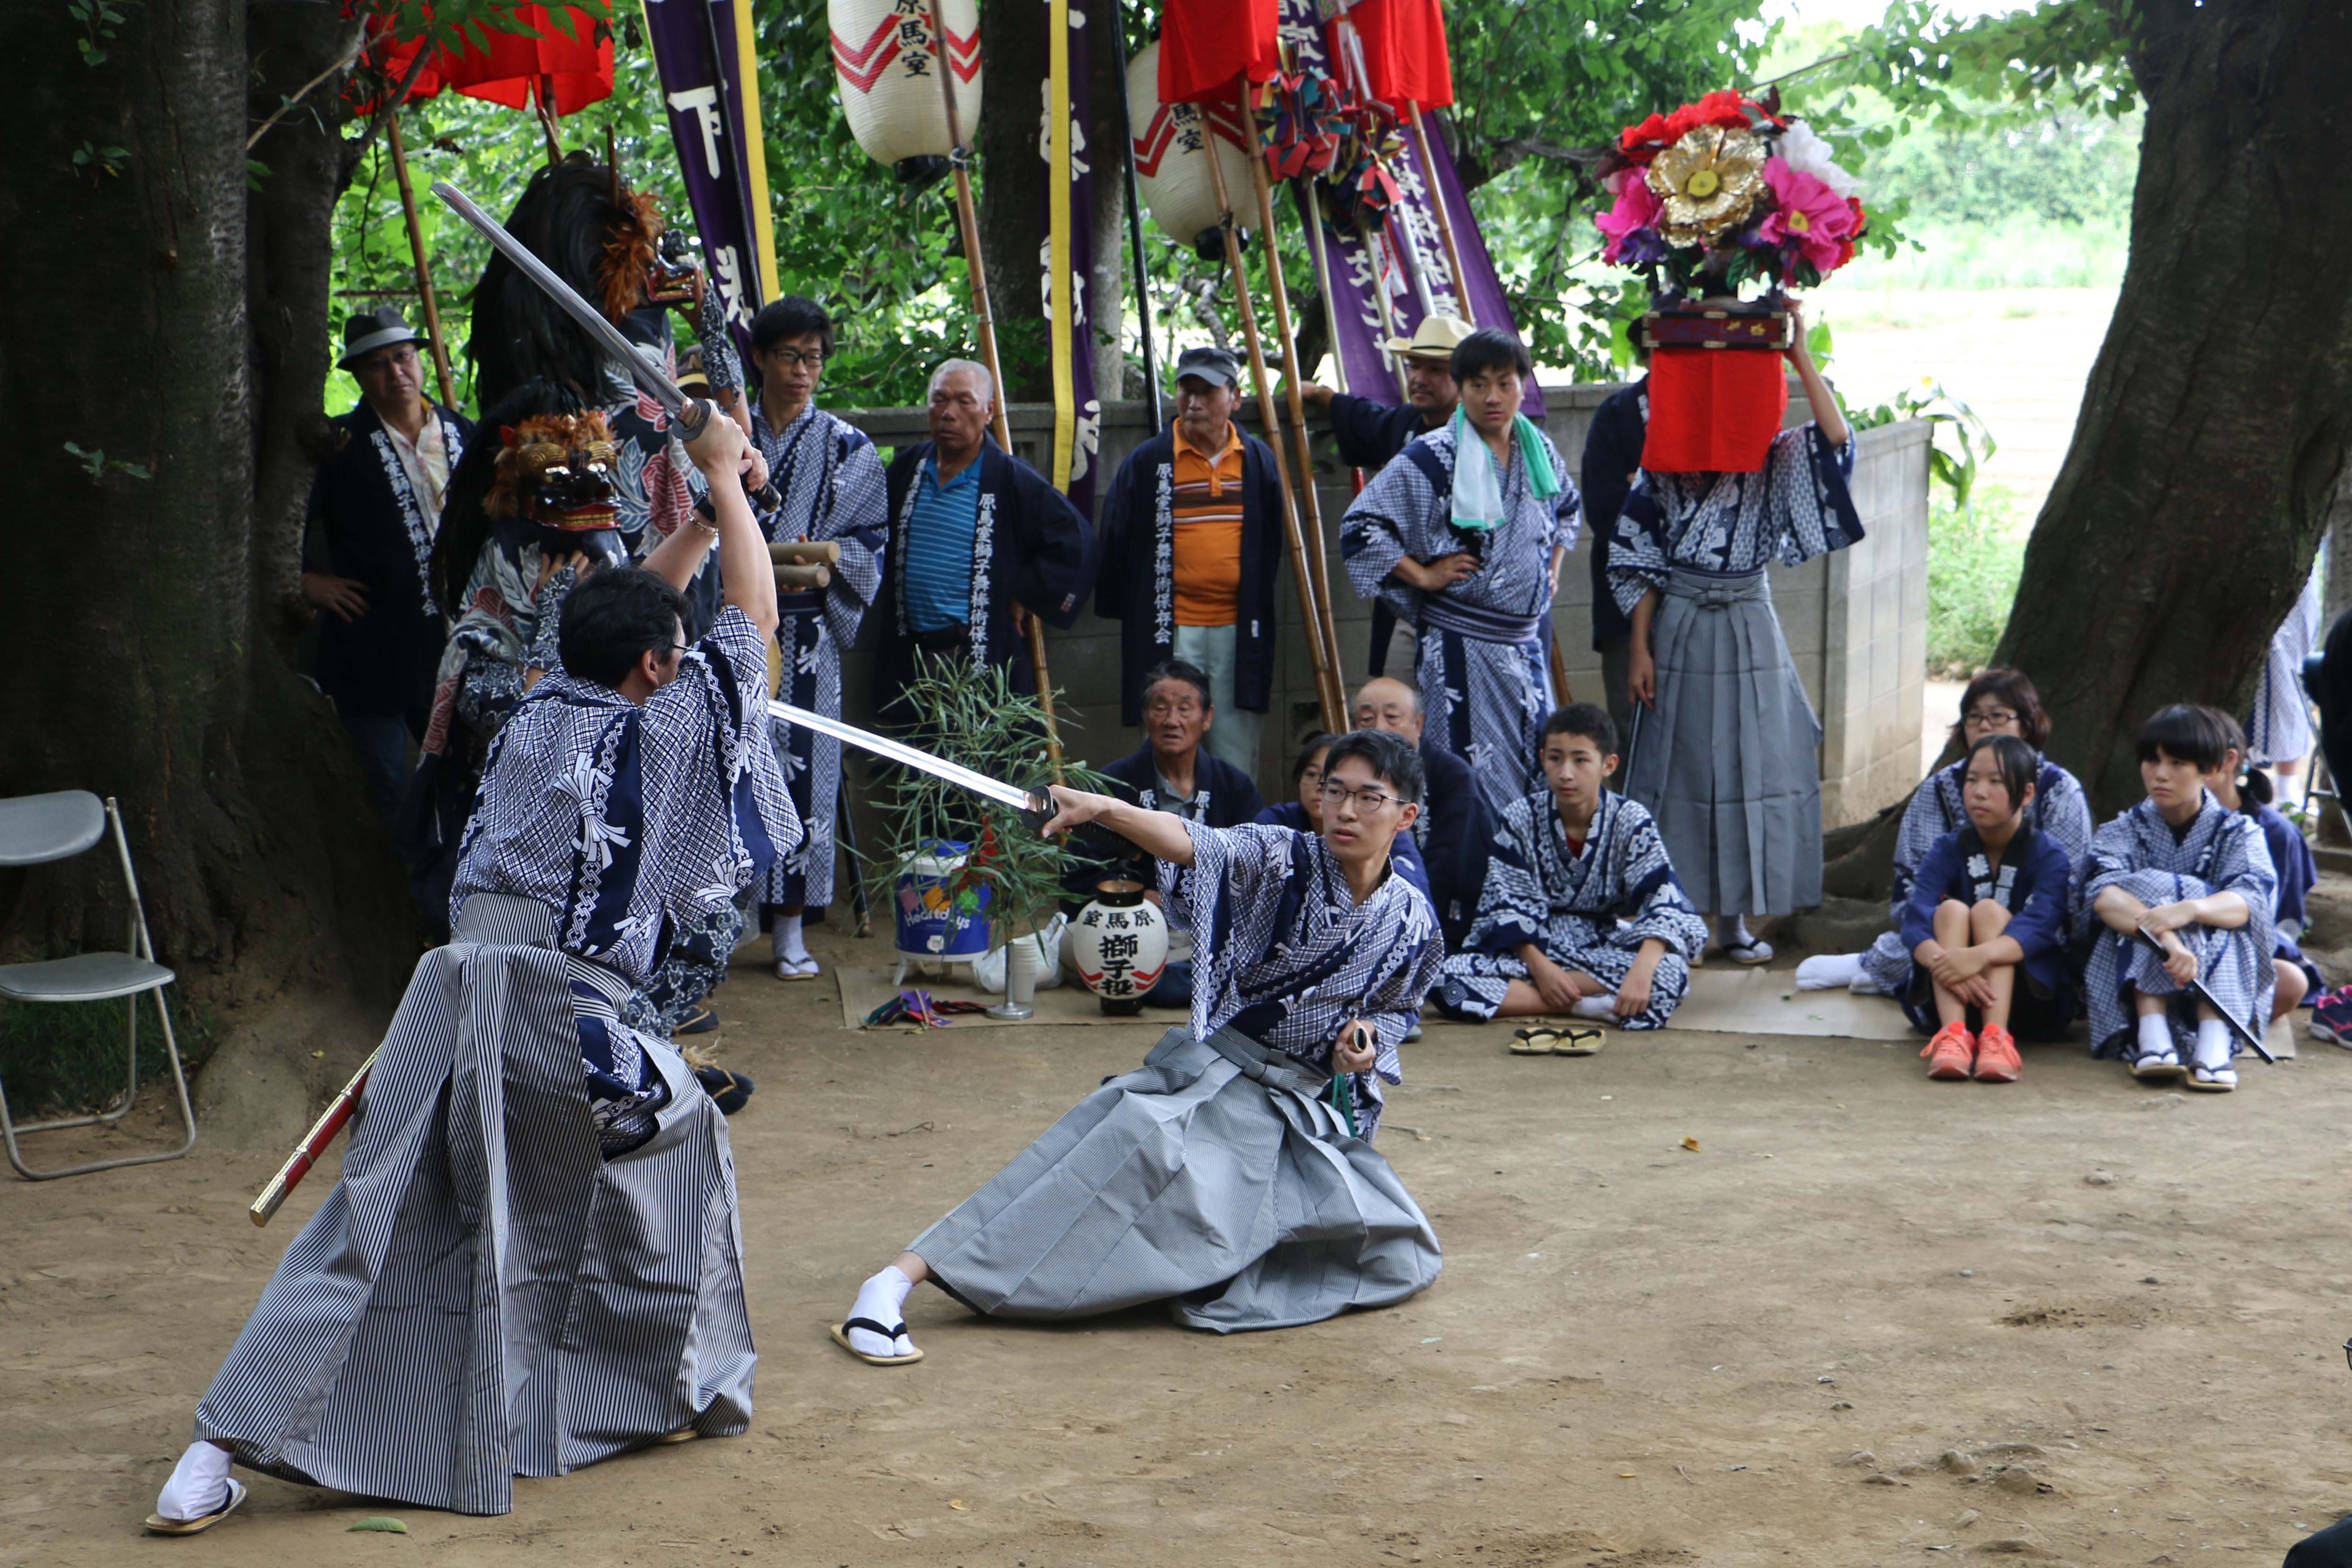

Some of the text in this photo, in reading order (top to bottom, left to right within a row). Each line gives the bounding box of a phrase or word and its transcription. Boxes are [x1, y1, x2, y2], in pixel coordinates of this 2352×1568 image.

[1154, 463, 1173, 644] 原馬室獅子舞棒術保存会
[1139, 789, 1157, 809] 原
[904, 908, 971, 930] Heartdys
[1083, 909, 1155, 929] 原馬室
